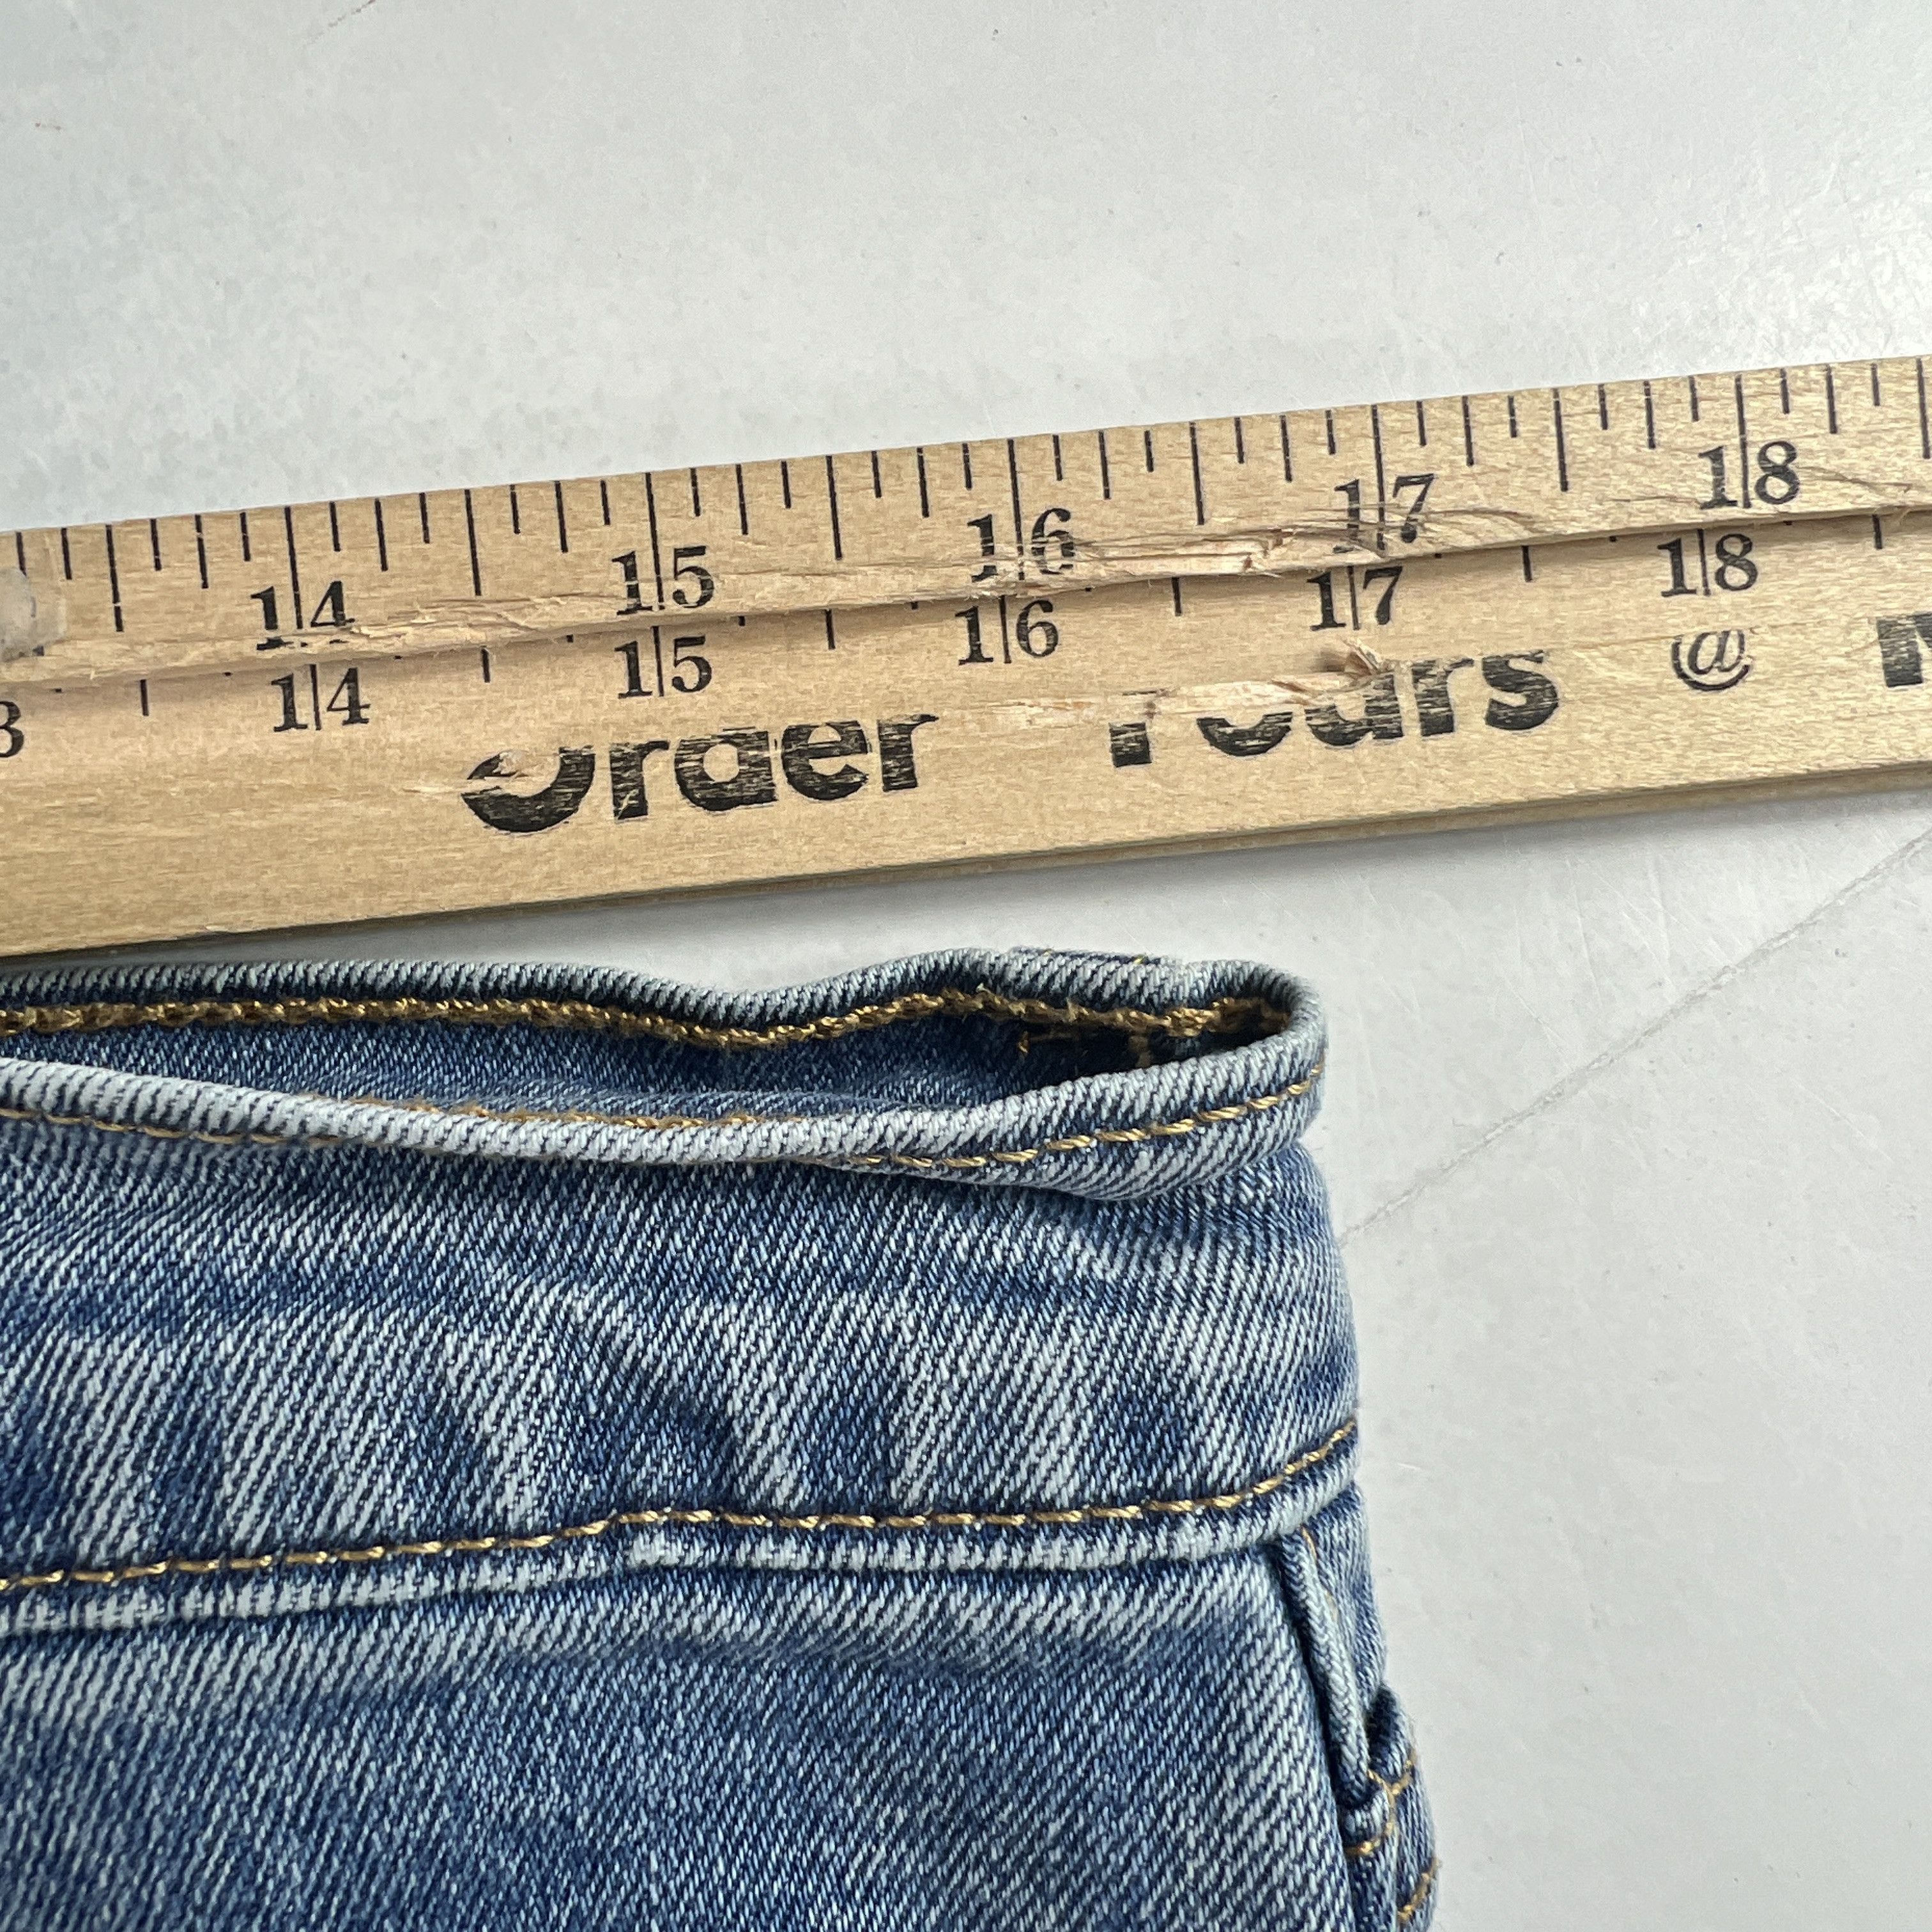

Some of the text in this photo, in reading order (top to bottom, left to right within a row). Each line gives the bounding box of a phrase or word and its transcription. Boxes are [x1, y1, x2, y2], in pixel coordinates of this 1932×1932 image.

[251, 440, 1801, 650] 14 15 16 17 18
[271, 667, 371, 732] 14
[614, 635, 713, 700] 15
[954, 599, 1059, 666] 16
[1305, 565, 1403, 631] 17
[1657, 533, 1759, 597] 18
